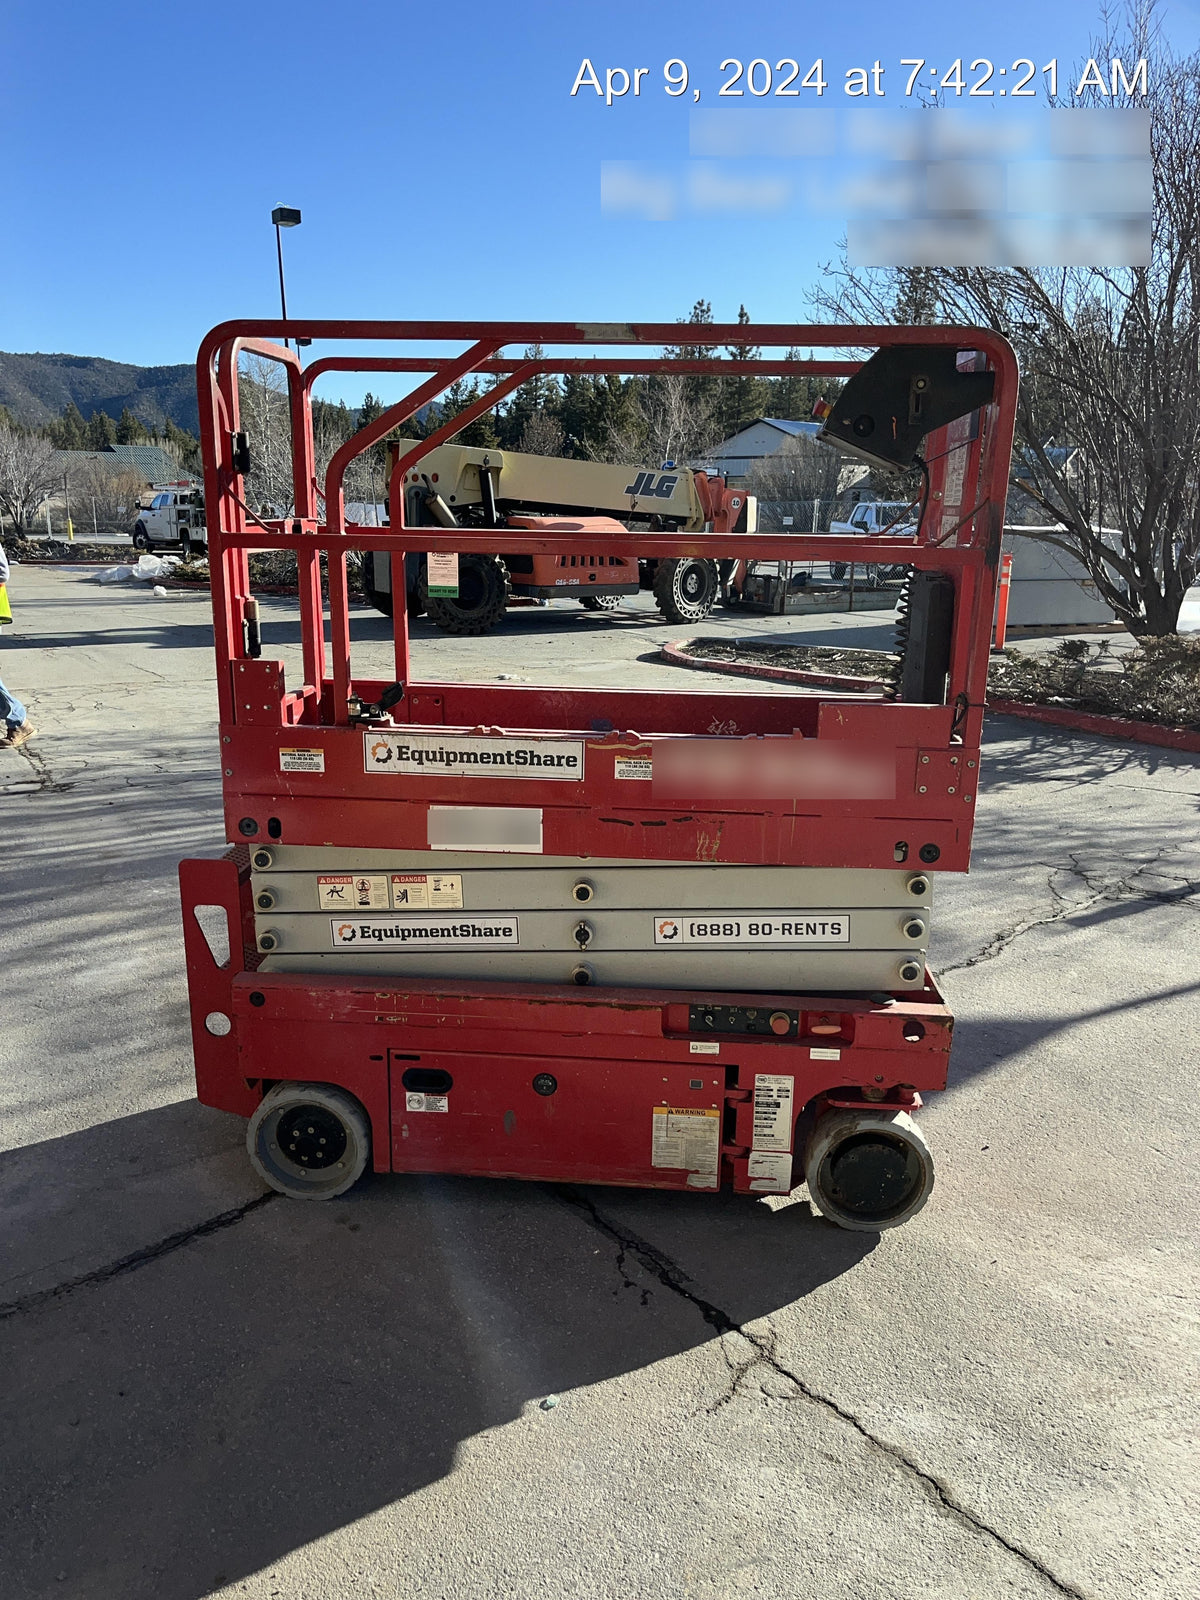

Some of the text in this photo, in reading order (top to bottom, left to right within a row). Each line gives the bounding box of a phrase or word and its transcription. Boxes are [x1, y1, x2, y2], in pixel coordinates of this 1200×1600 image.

[625, 472, 679, 499] JLG
[397, 744, 579, 769] EquipmentShare
[359, 923, 513, 942] EquipmentShare
[689, 921, 842, 937] (888) 80-RENTS
[675, 1108, 706, 1116] WARNING
